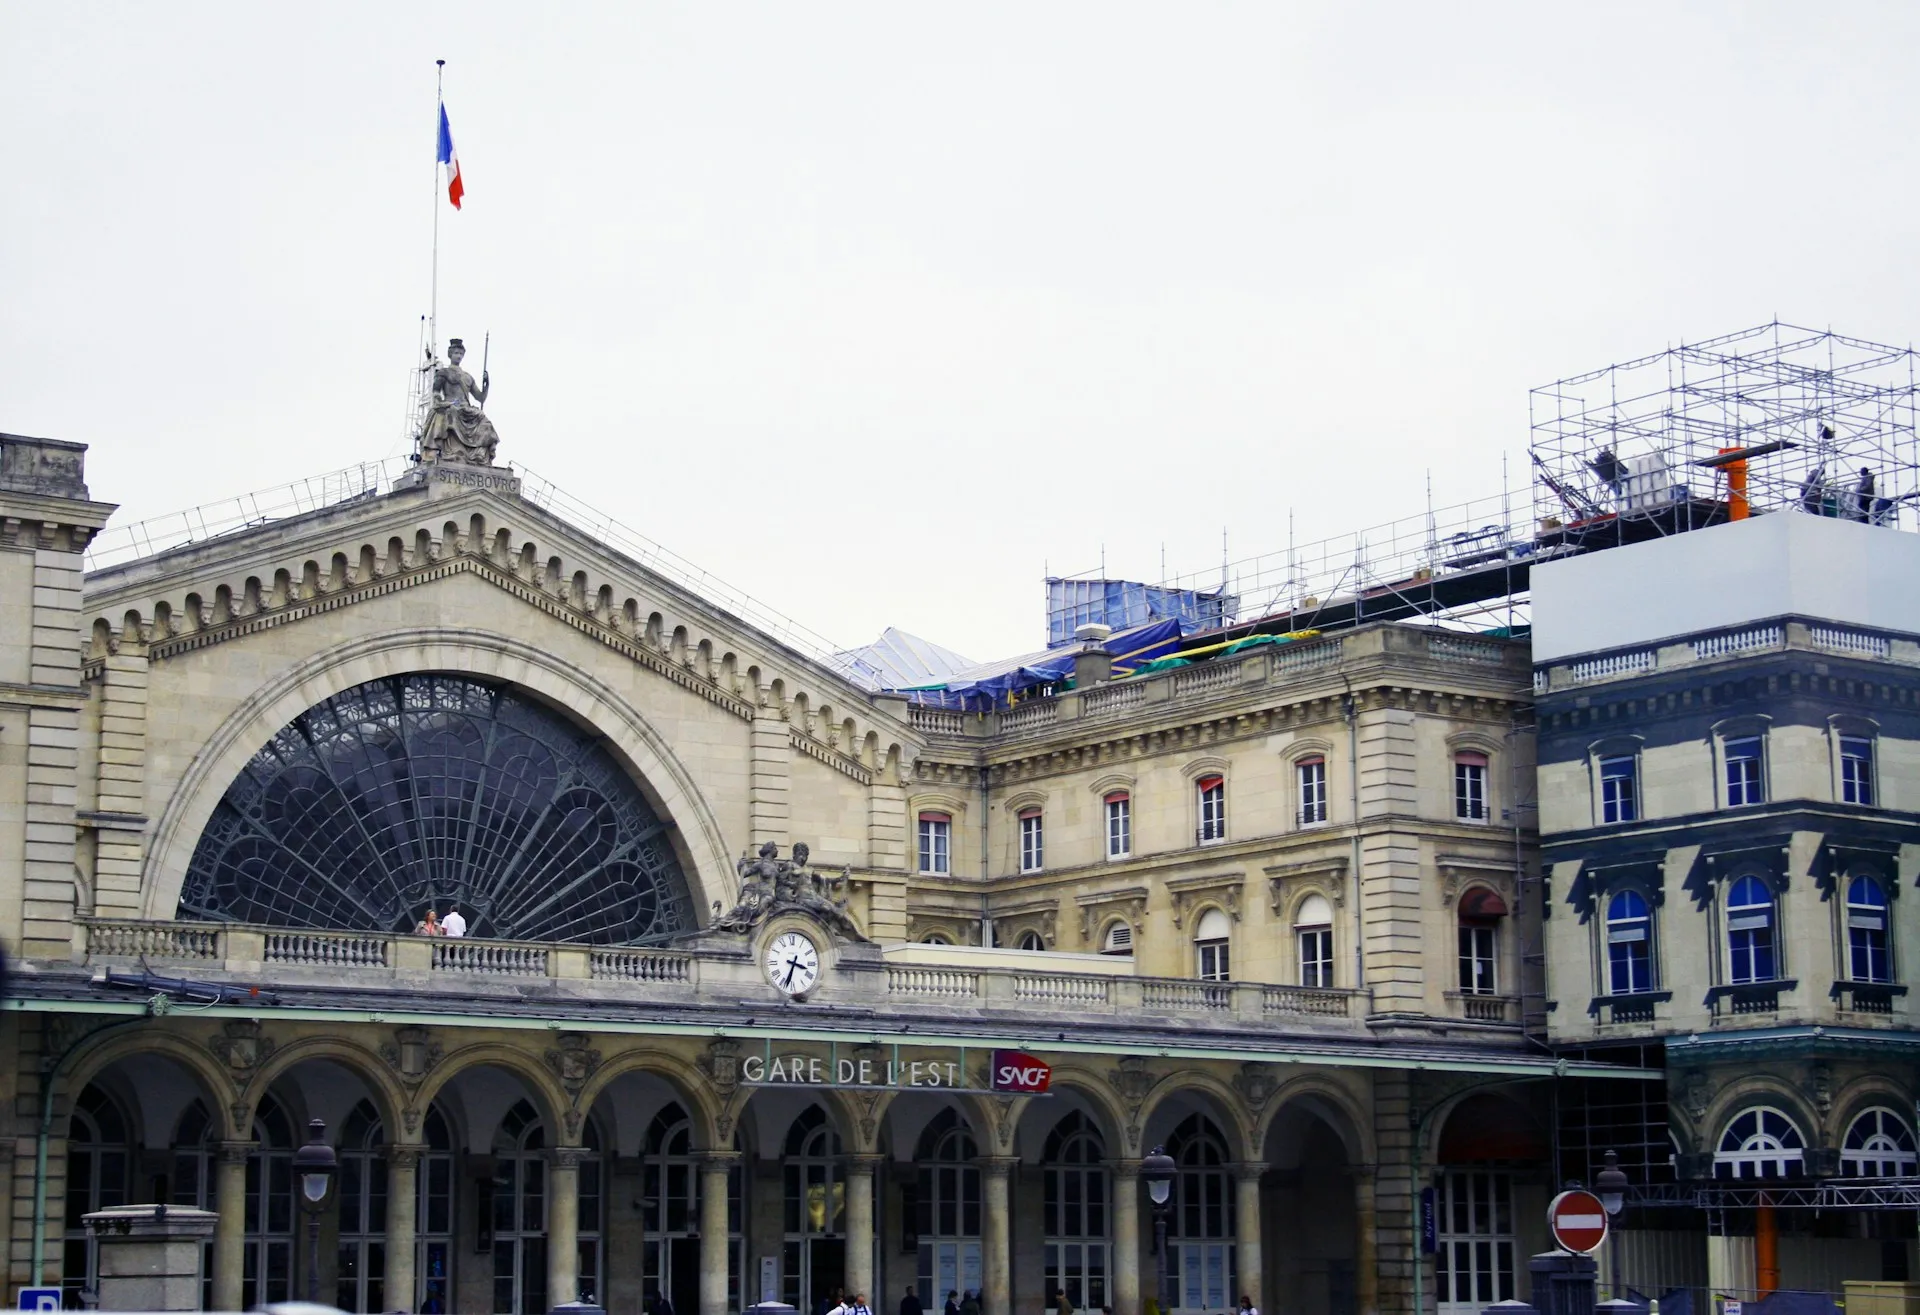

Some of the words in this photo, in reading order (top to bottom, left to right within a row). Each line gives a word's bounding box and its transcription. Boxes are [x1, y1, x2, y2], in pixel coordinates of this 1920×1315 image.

[439, 469, 517, 493] STRASBOVRG
[743, 1055, 822, 1083] GARE
[838, 1059, 872, 1084] DE
[886, 1061, 957, 1087] L'EST
[996, 1066, 1049, 1086] SNCF
